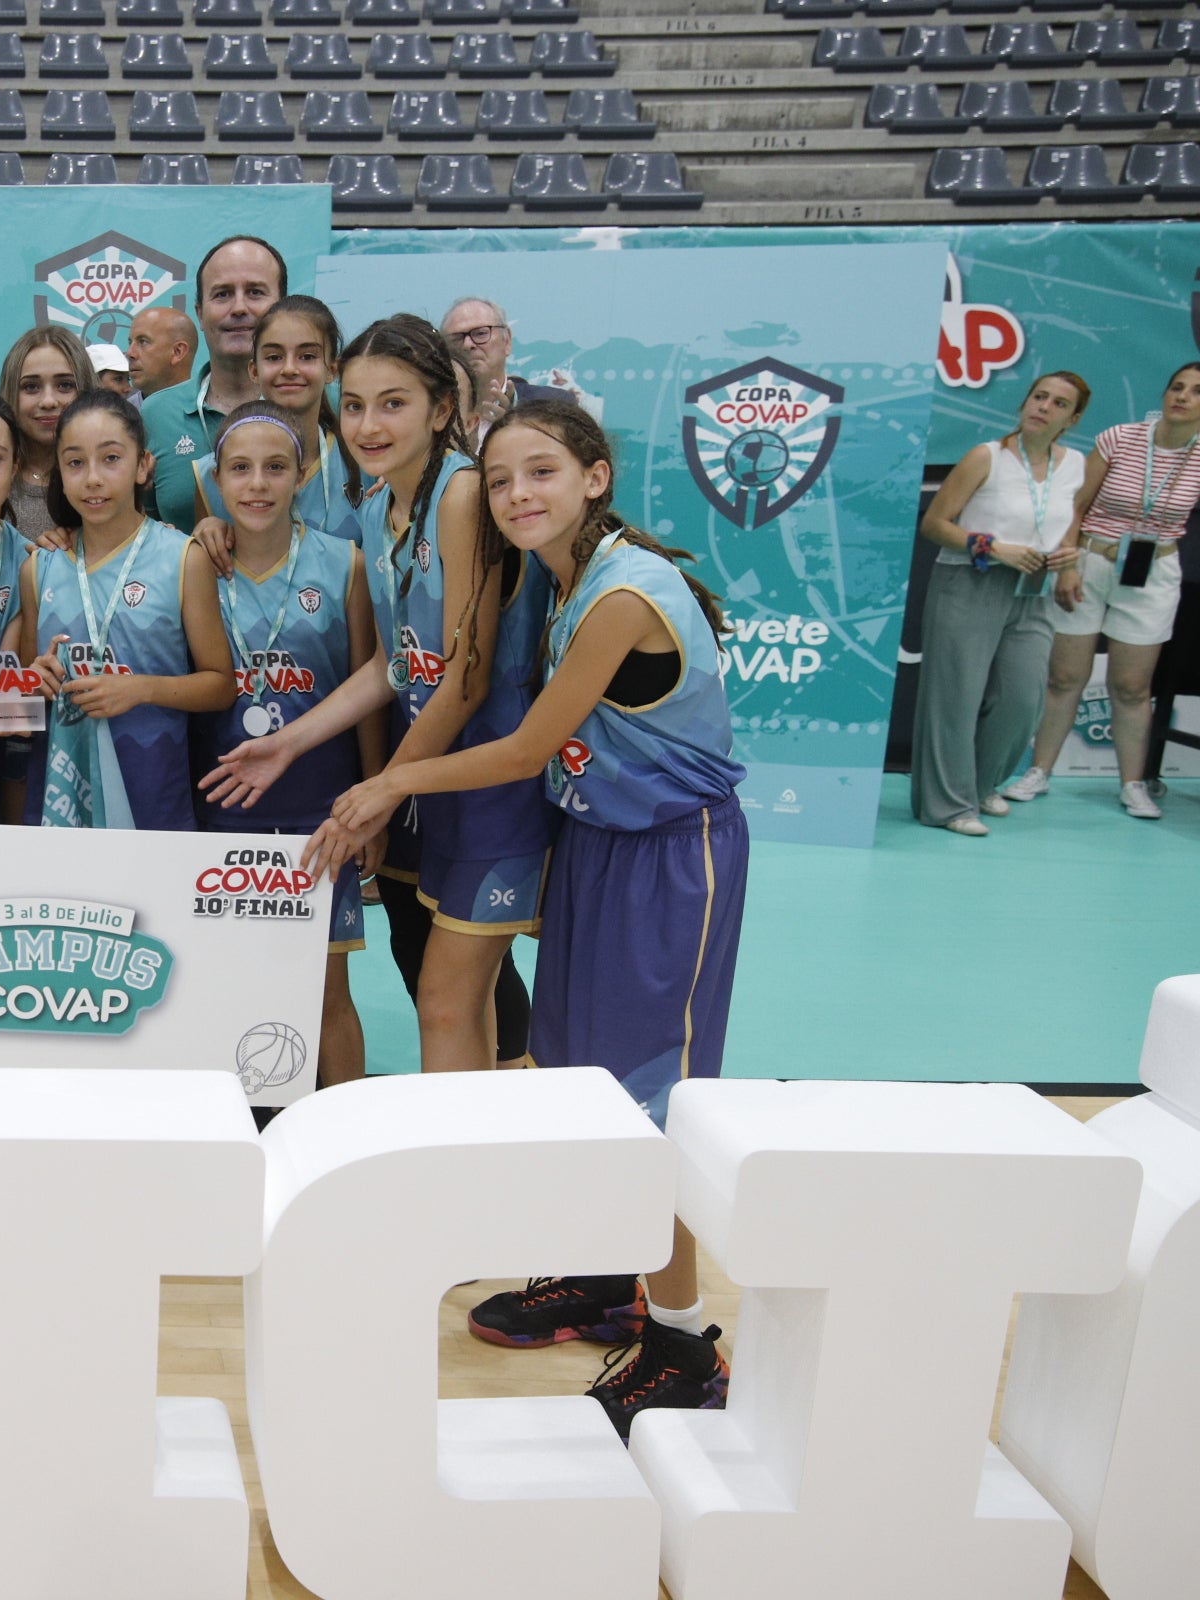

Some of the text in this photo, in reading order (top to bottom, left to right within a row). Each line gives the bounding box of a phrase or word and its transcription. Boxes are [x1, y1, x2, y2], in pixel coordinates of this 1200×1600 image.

[666, 21, 700, 30] FILA
[702, 75, 737, 86] FILA
[752, 136, 807, 148] FILA 4
[804, 207, 844, 219] FILA
[83, 263, 138, 280] COPA
[66, 281, 154, 304] COVAP
[735, 387, 792, 402] COPA
[716, 403, 808, 424] COVAP
[718, 610, 830, 646] évete
[719, 645, 822, 684] VAP
[224, 849, 287, 868] COPA
[196, 867, 313, 895] COVAP
[4, 904, 15, 920] 3
[20, 906, 33, 919] al
[39, 904, 50, 919] 8
[56, 907, 75, 921] DE
[80, 905, 123, 928] julio
[235, 898, 310, 917] FINAL
